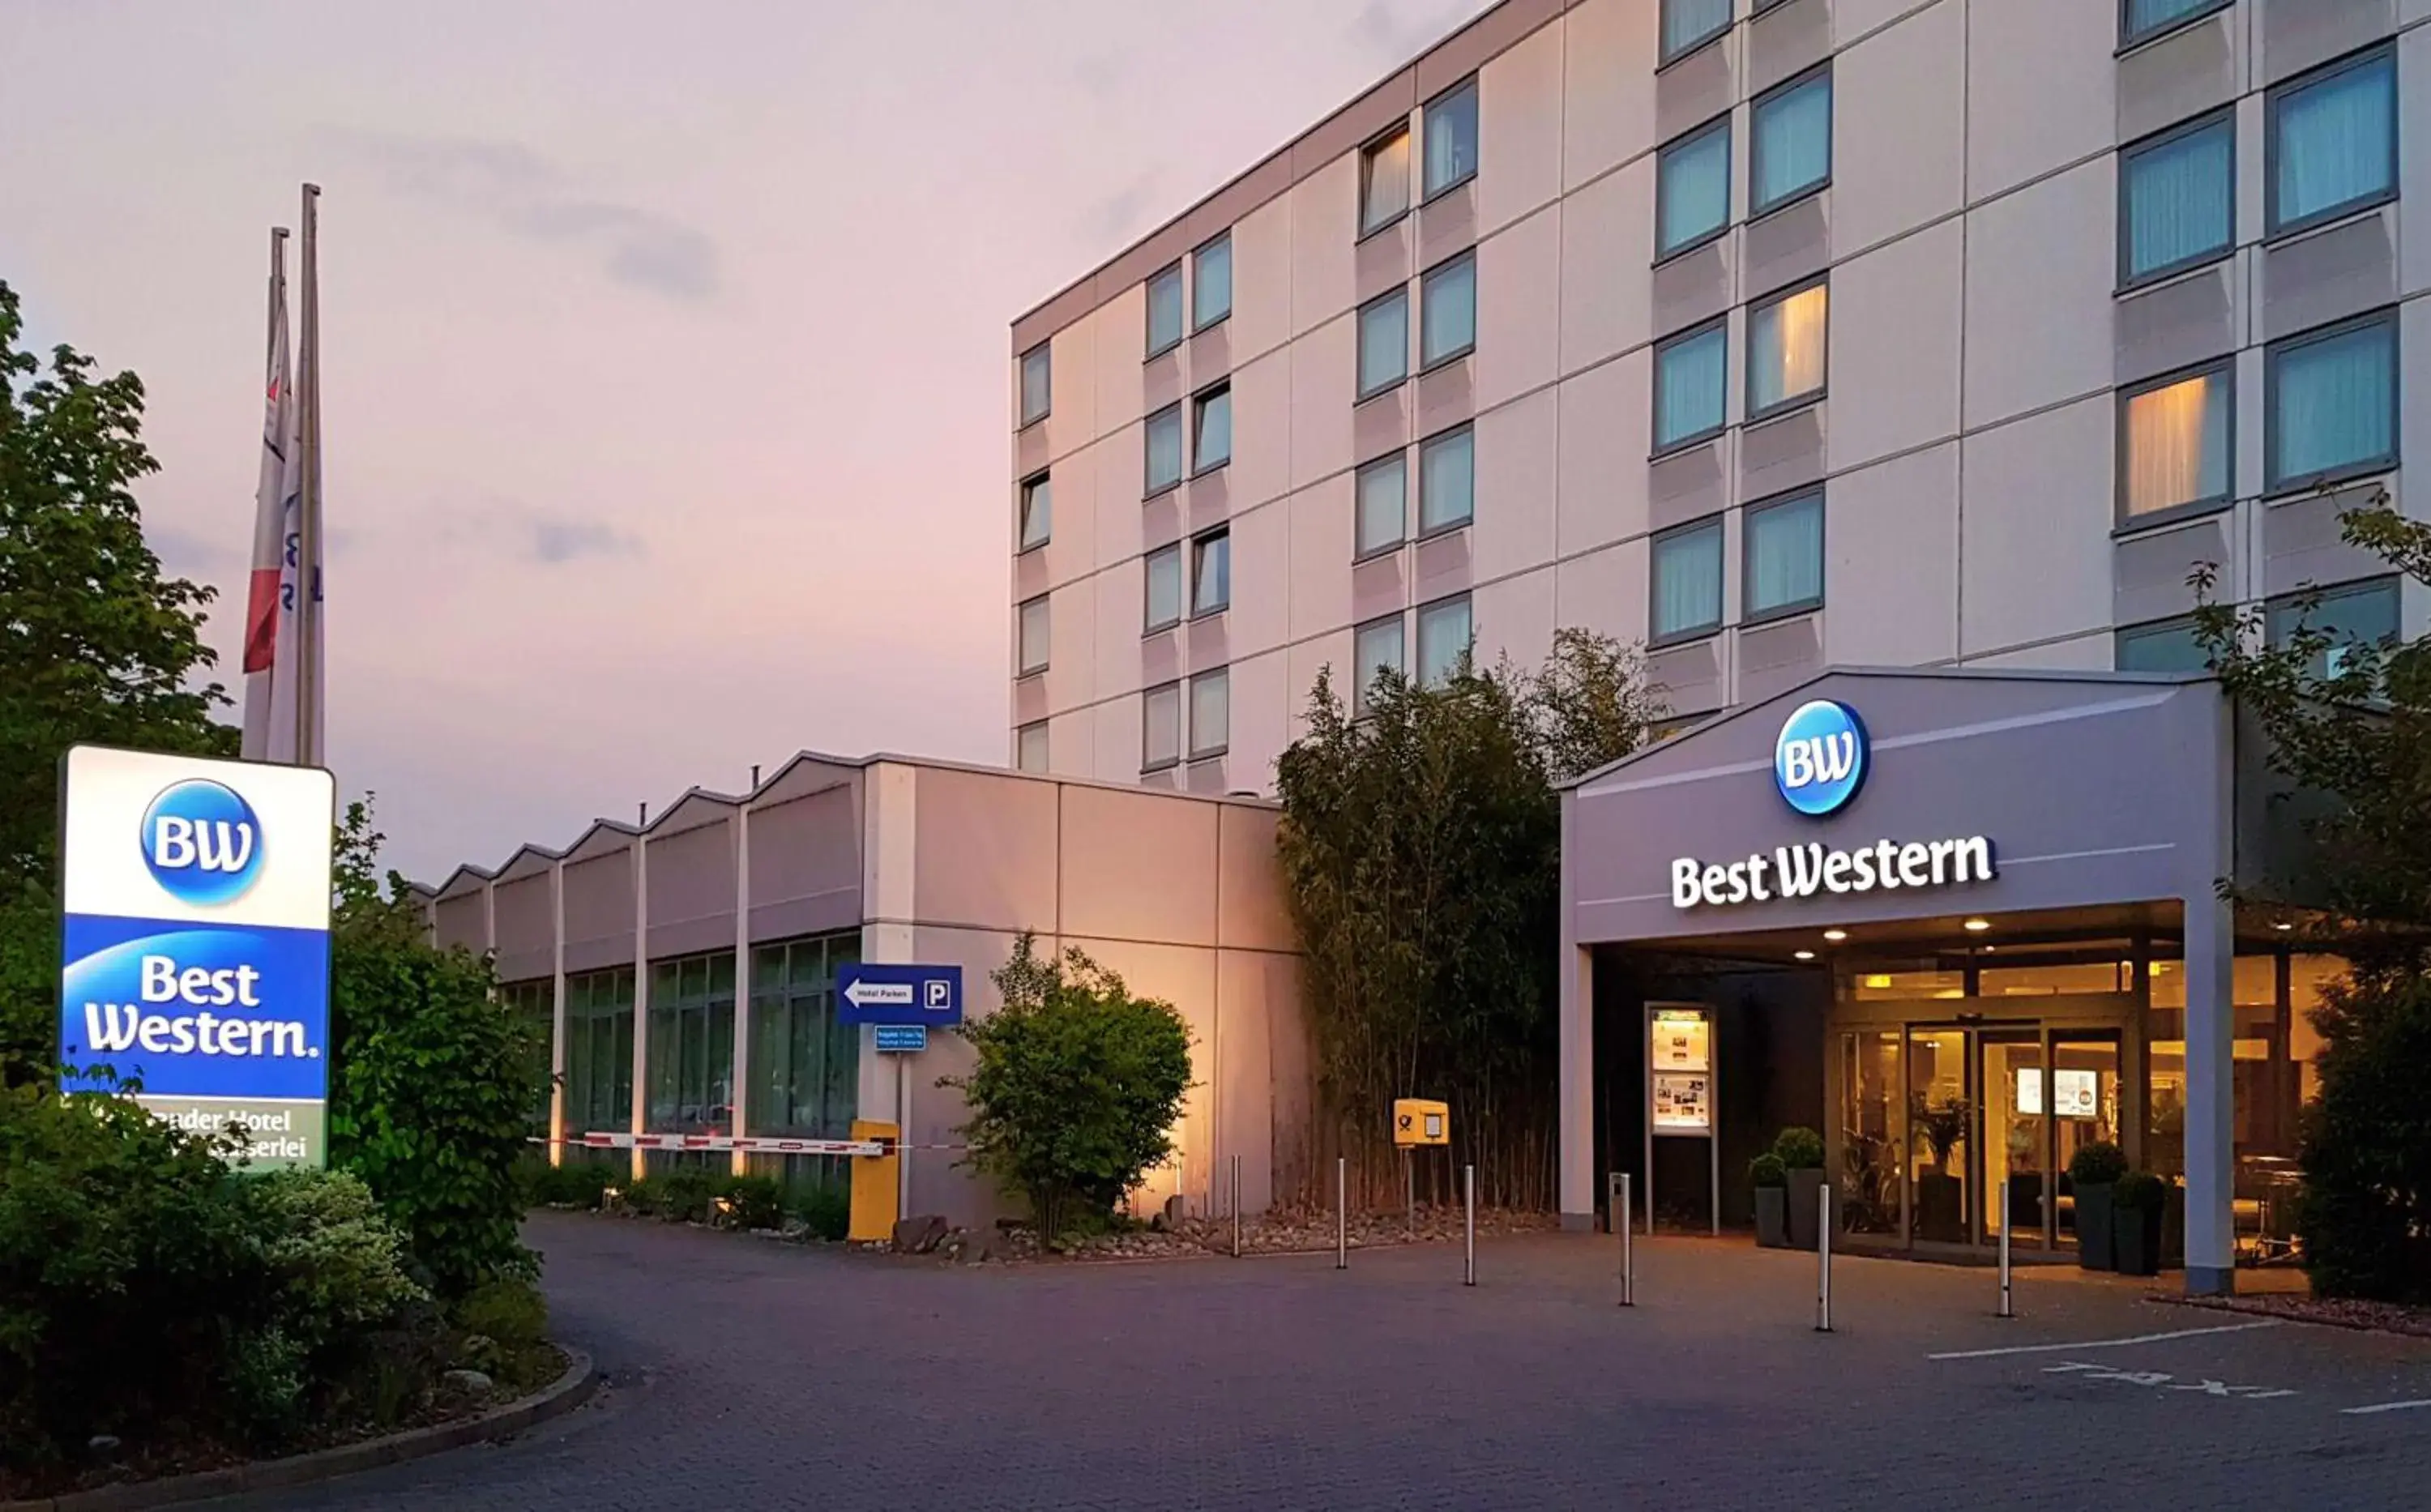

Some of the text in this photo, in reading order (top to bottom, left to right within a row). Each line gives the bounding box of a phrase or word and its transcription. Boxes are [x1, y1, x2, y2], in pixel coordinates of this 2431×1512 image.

[1784, 731, 1854, 788] BW
[154, 815, 253, 873] BW
[1671, 835, 1993, 908] Best Western
[141, 955, 261, 1007] Best
[929, 984, 946, 1006] P
